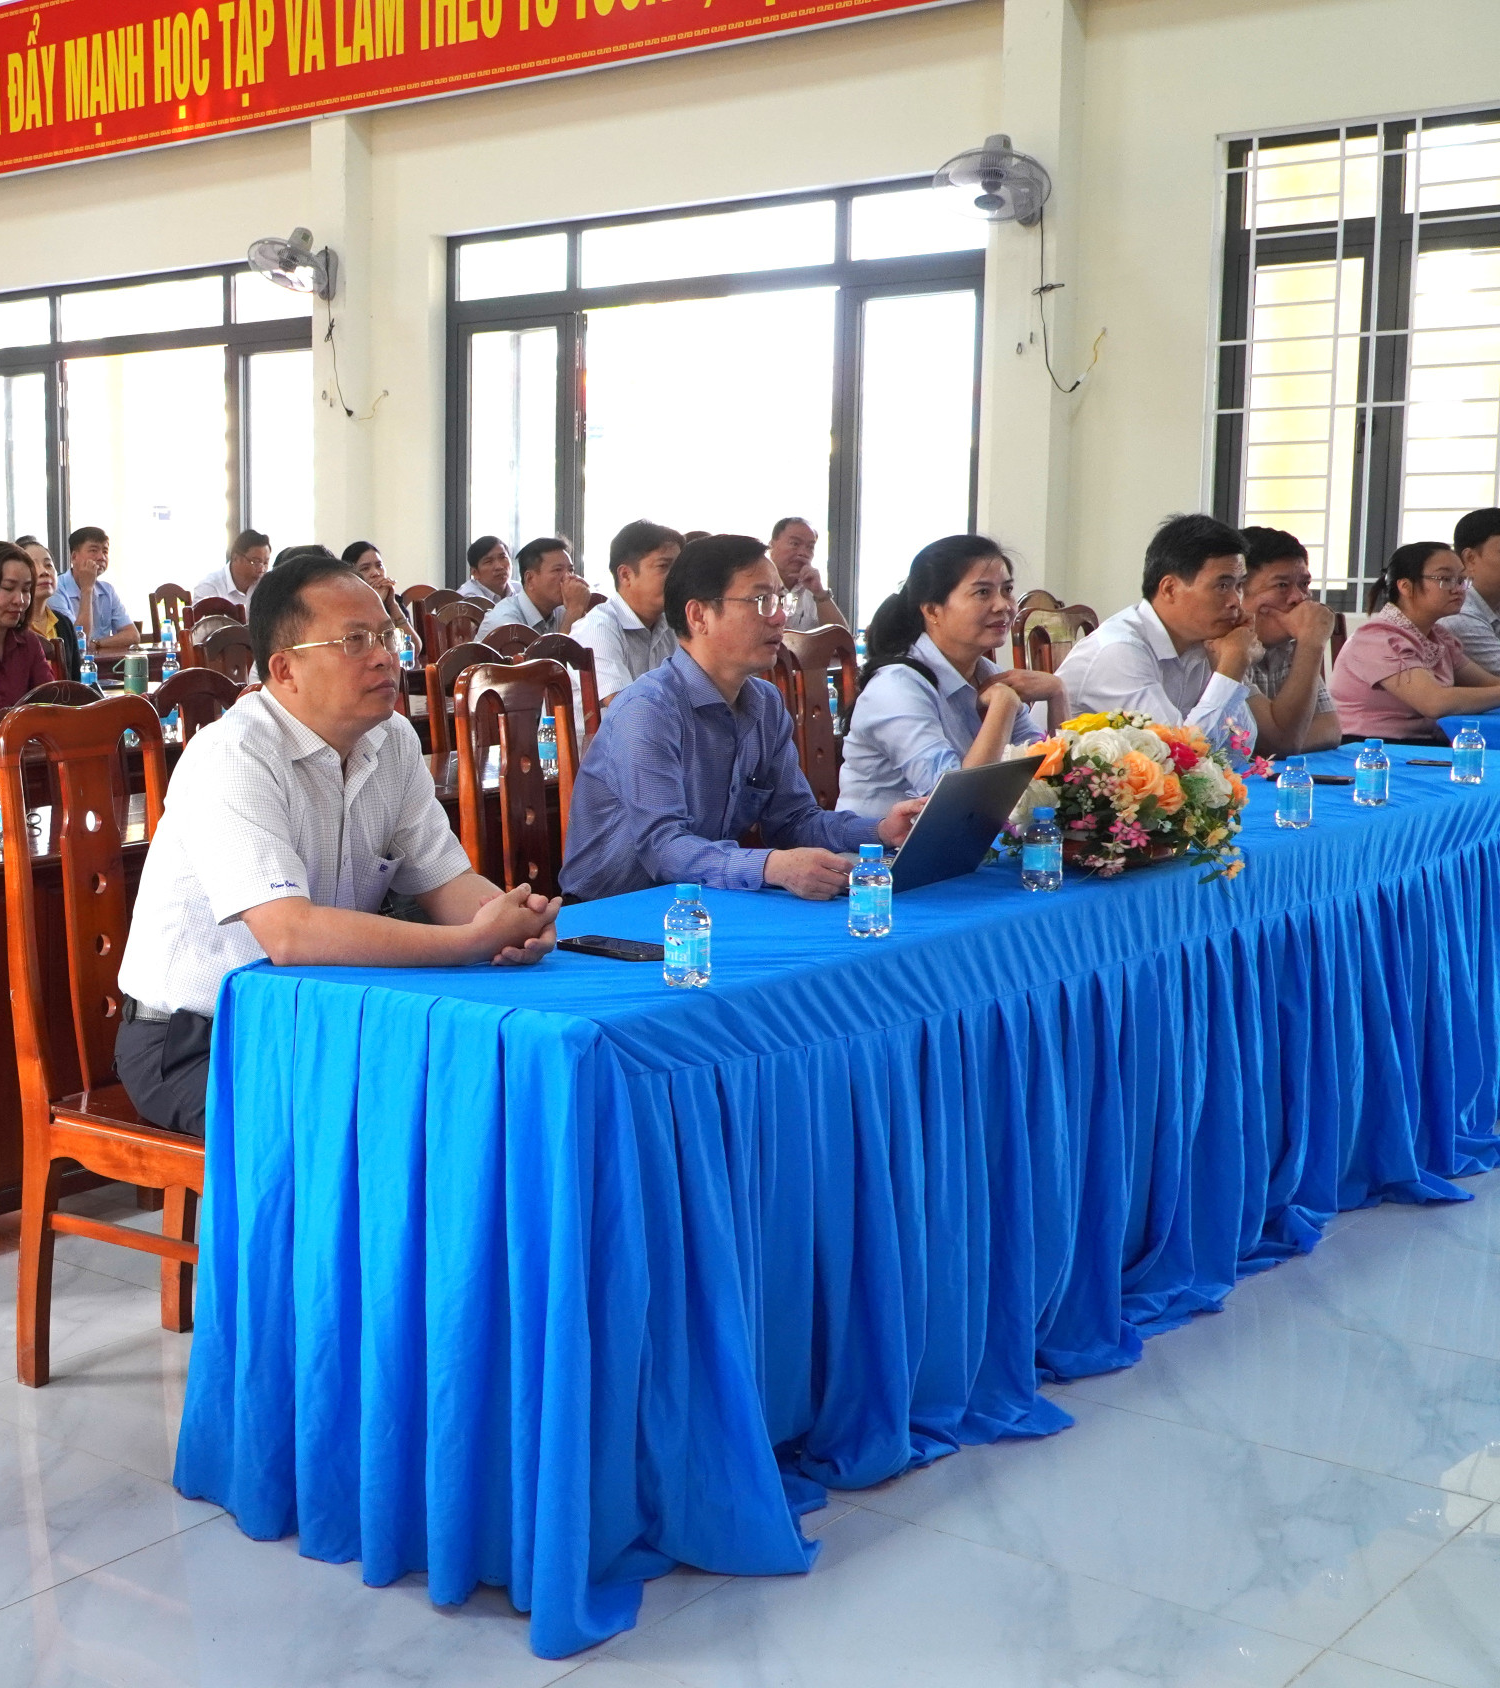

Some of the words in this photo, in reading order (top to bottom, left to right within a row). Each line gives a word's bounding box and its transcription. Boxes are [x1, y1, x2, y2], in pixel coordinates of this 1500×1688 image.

[7, 12, 56, 133] ĐẨY
[64, 23, 145, 136] MẠNH
[153, 7, 210, 120] HỌC
[51, 683, 71, 704] 20
